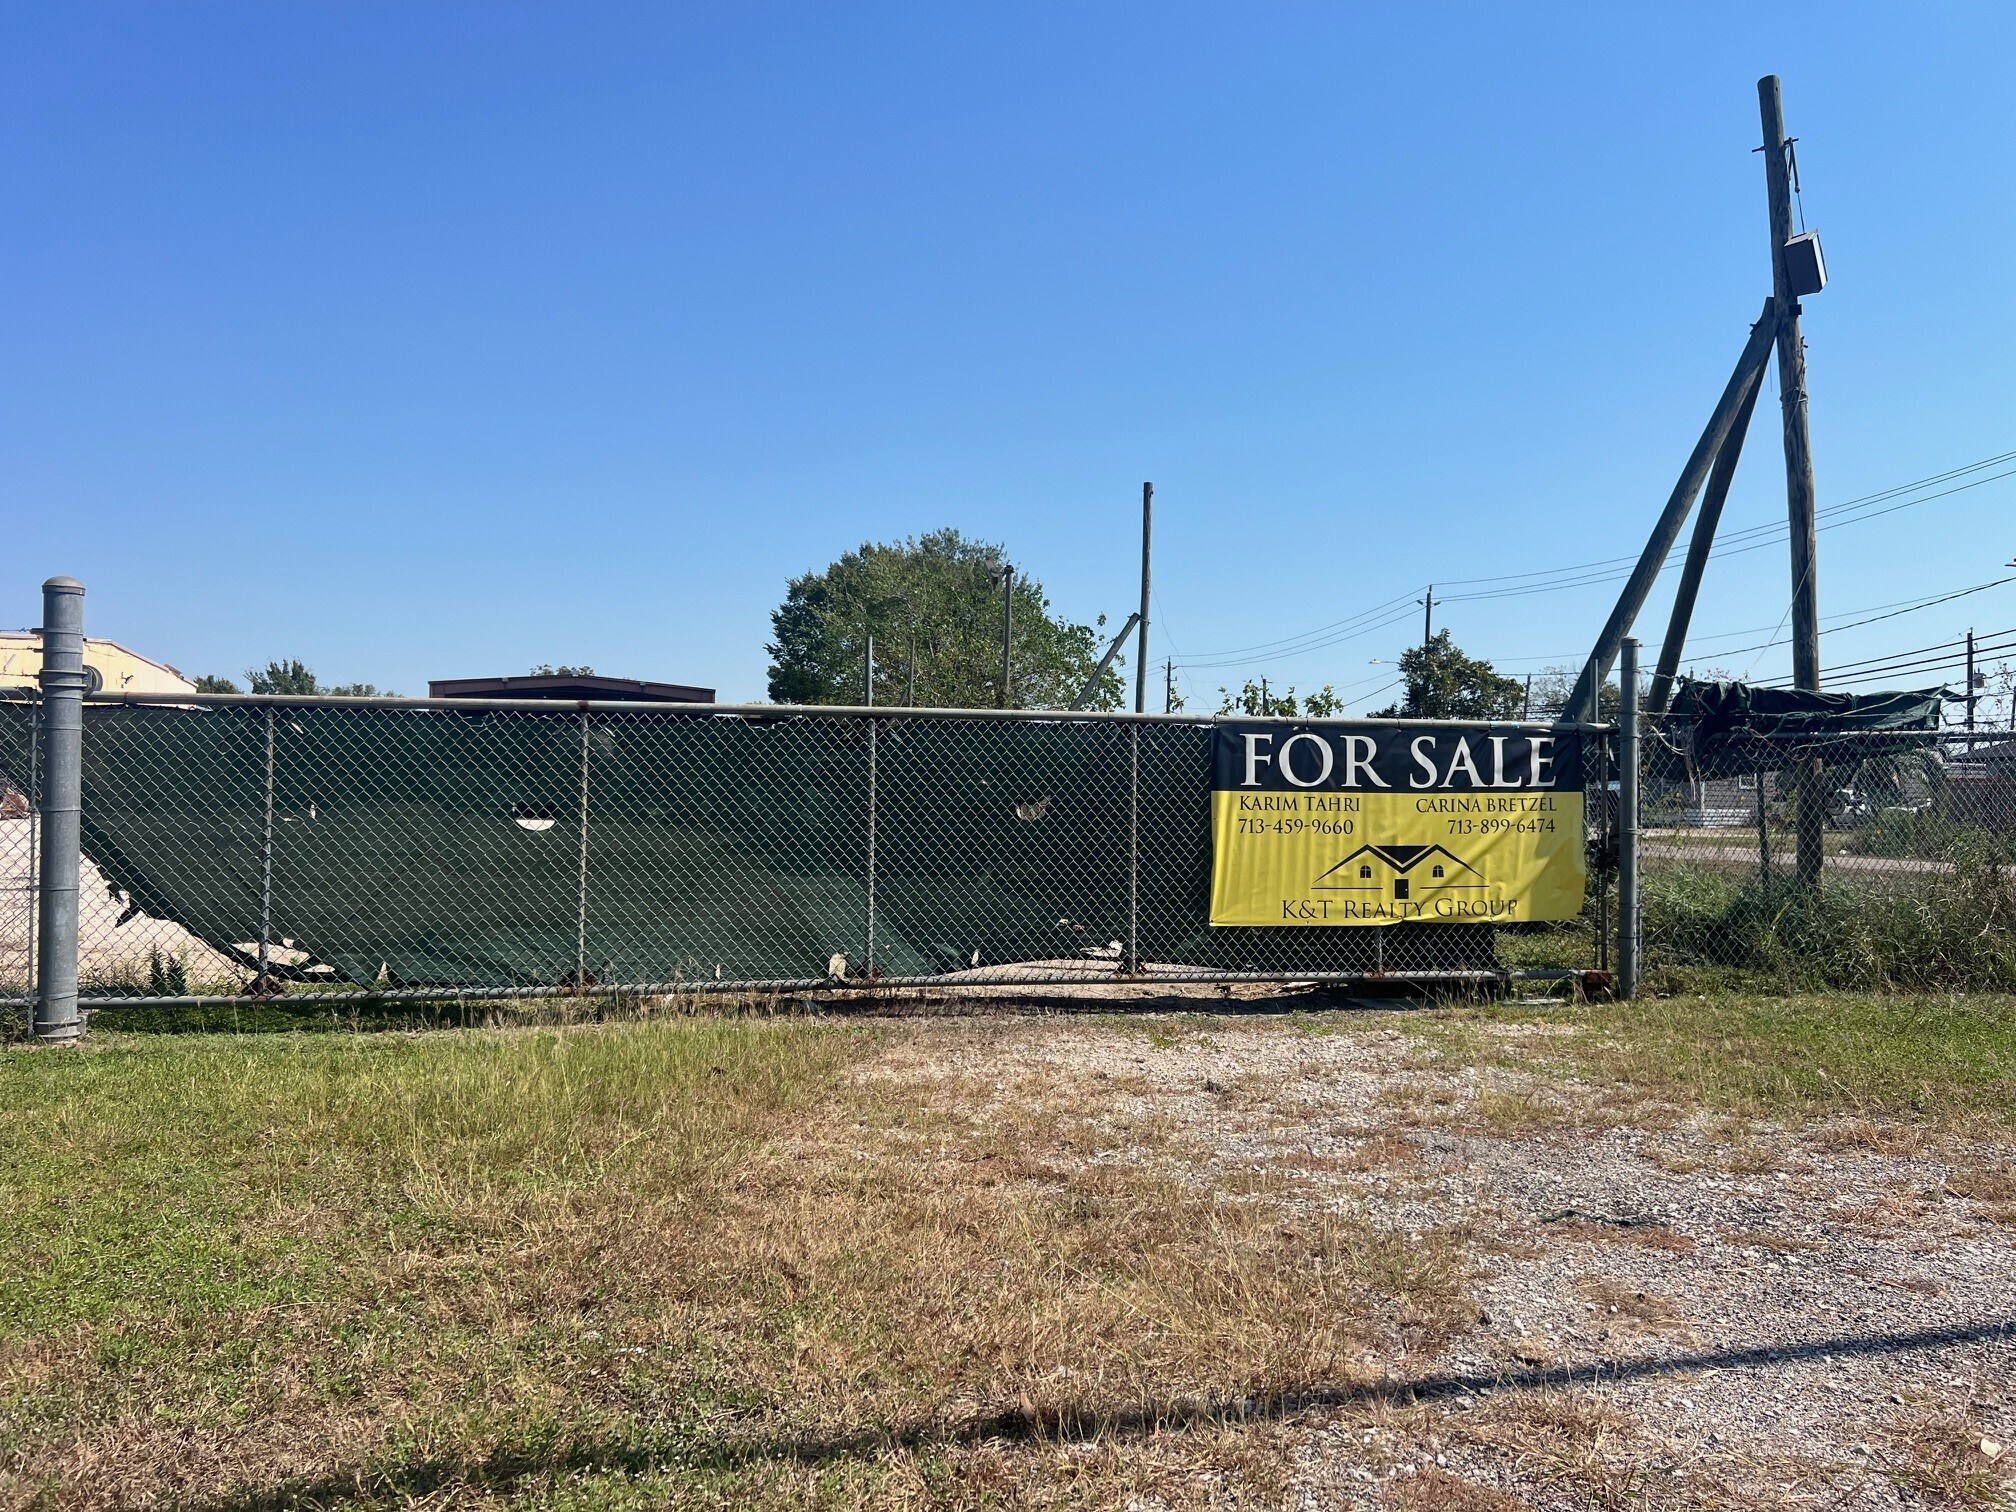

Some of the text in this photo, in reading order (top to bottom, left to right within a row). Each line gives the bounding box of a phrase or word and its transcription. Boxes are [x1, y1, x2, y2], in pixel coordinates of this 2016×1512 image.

[1239, 733, 1557, 789] FOR SALE
[1239, 795, 1360, 812] KARIM TAHRI
[1415, 797, 1557, 813] CARINA BRETZEL
[1238, 818, 1354, 835] 713-459-9660
[1447, 818, 1556, 835] 713-899-6474
[1282, 900, 1333, 919] K&T
